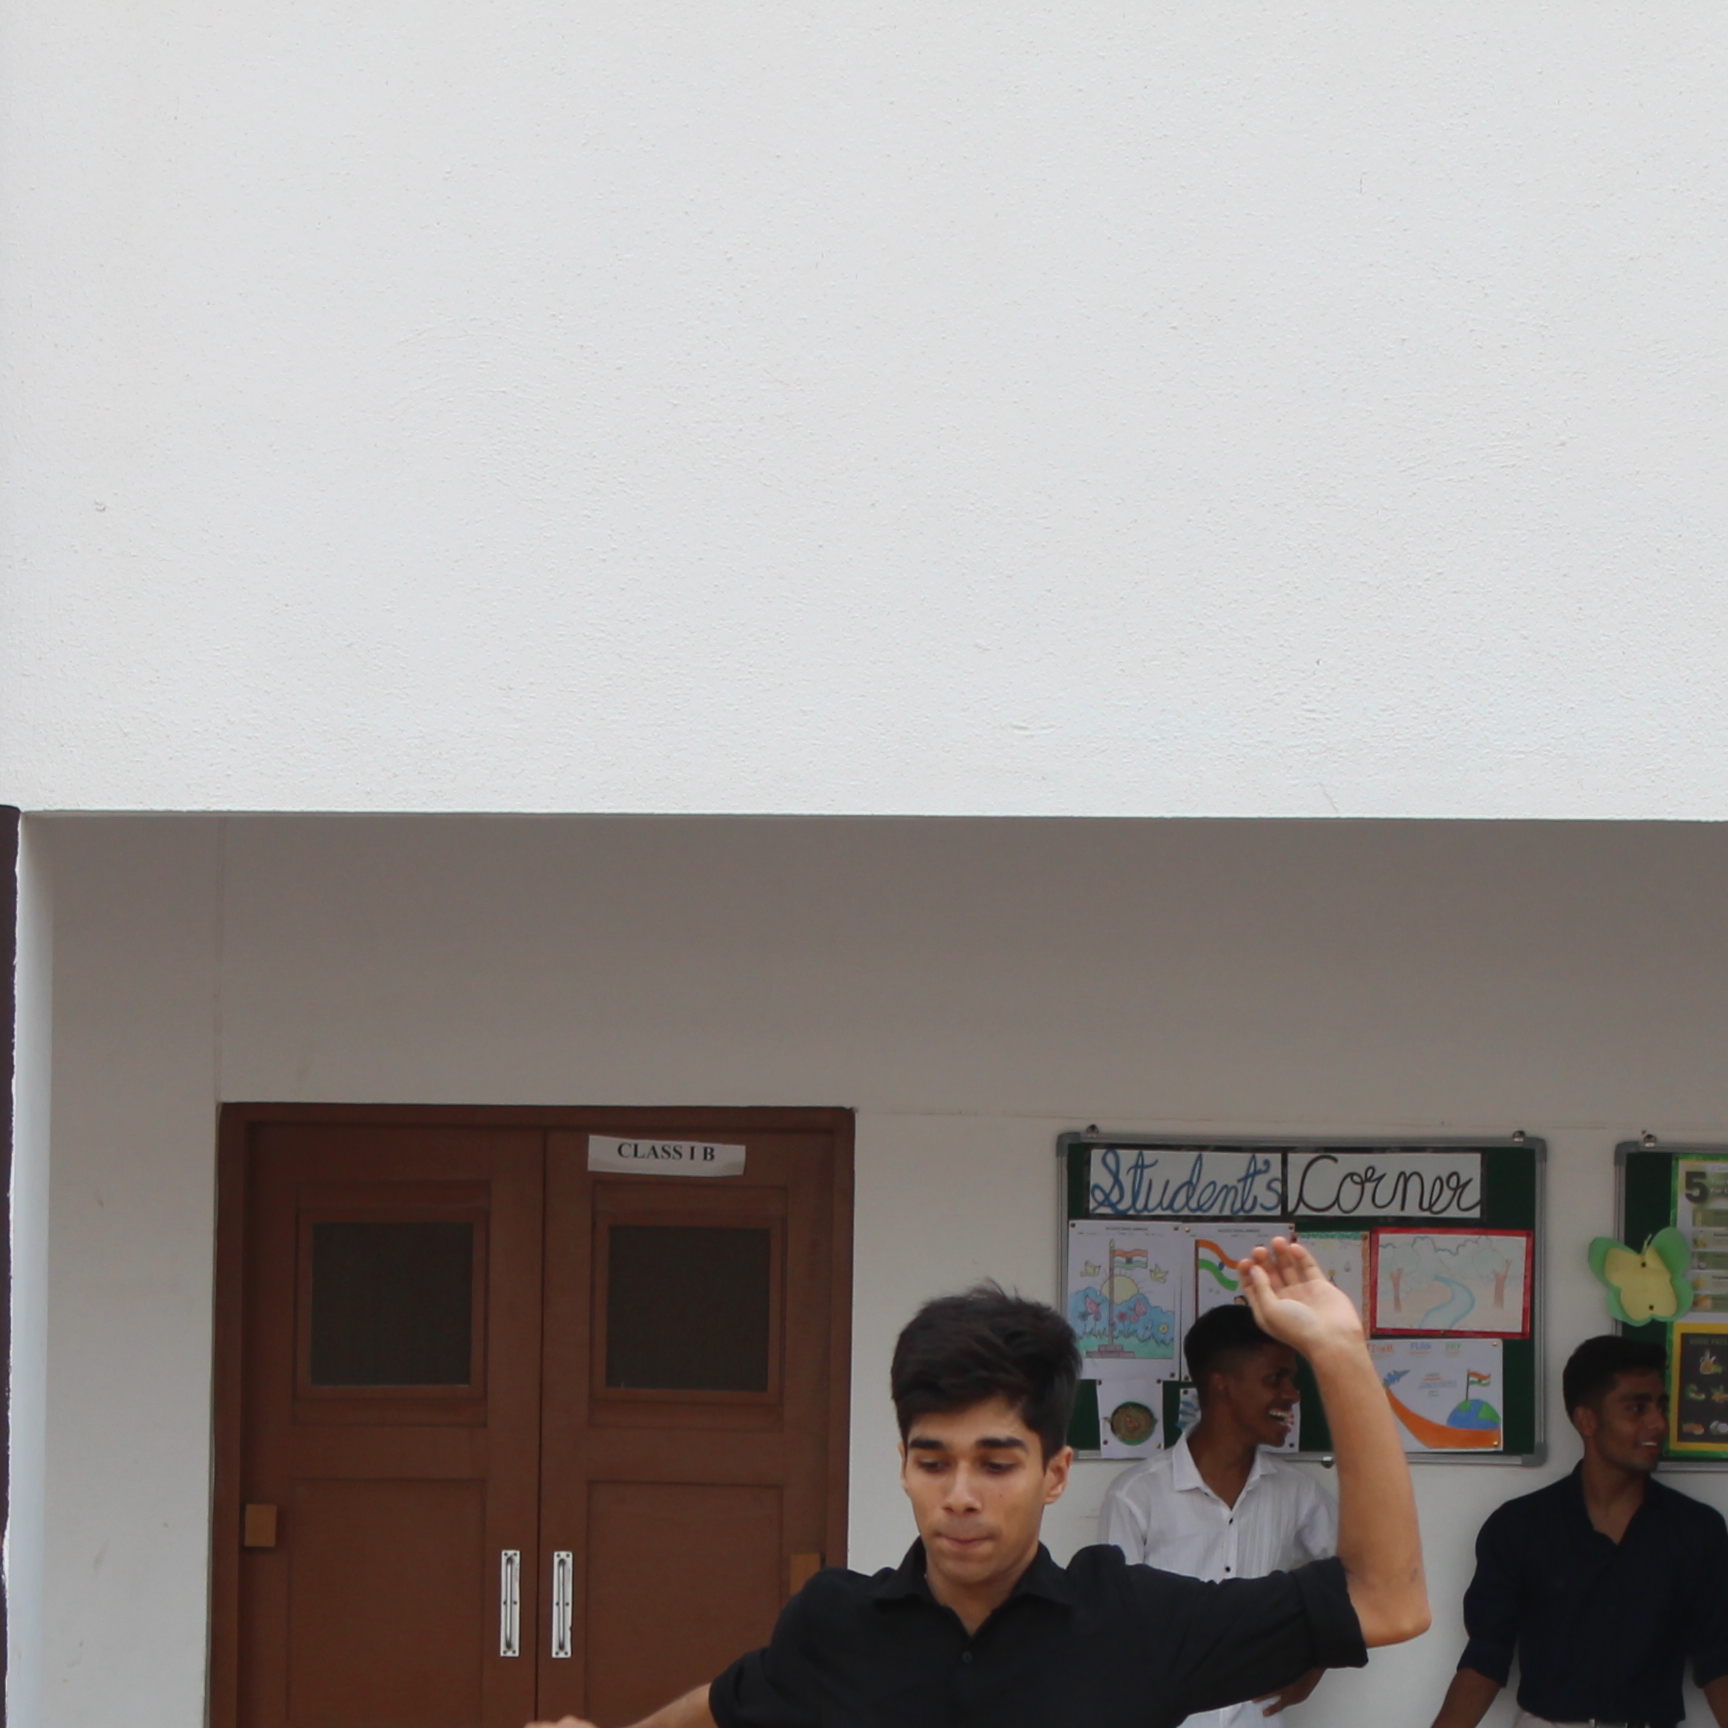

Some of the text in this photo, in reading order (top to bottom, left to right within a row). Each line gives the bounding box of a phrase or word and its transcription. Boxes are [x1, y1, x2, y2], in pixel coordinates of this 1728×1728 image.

[617, 1142, 715, 1161] CLASS I B
[1090, 1148, 1482, 1216] Student's Corner
[1685, 1171, 1709, 1204] 5
